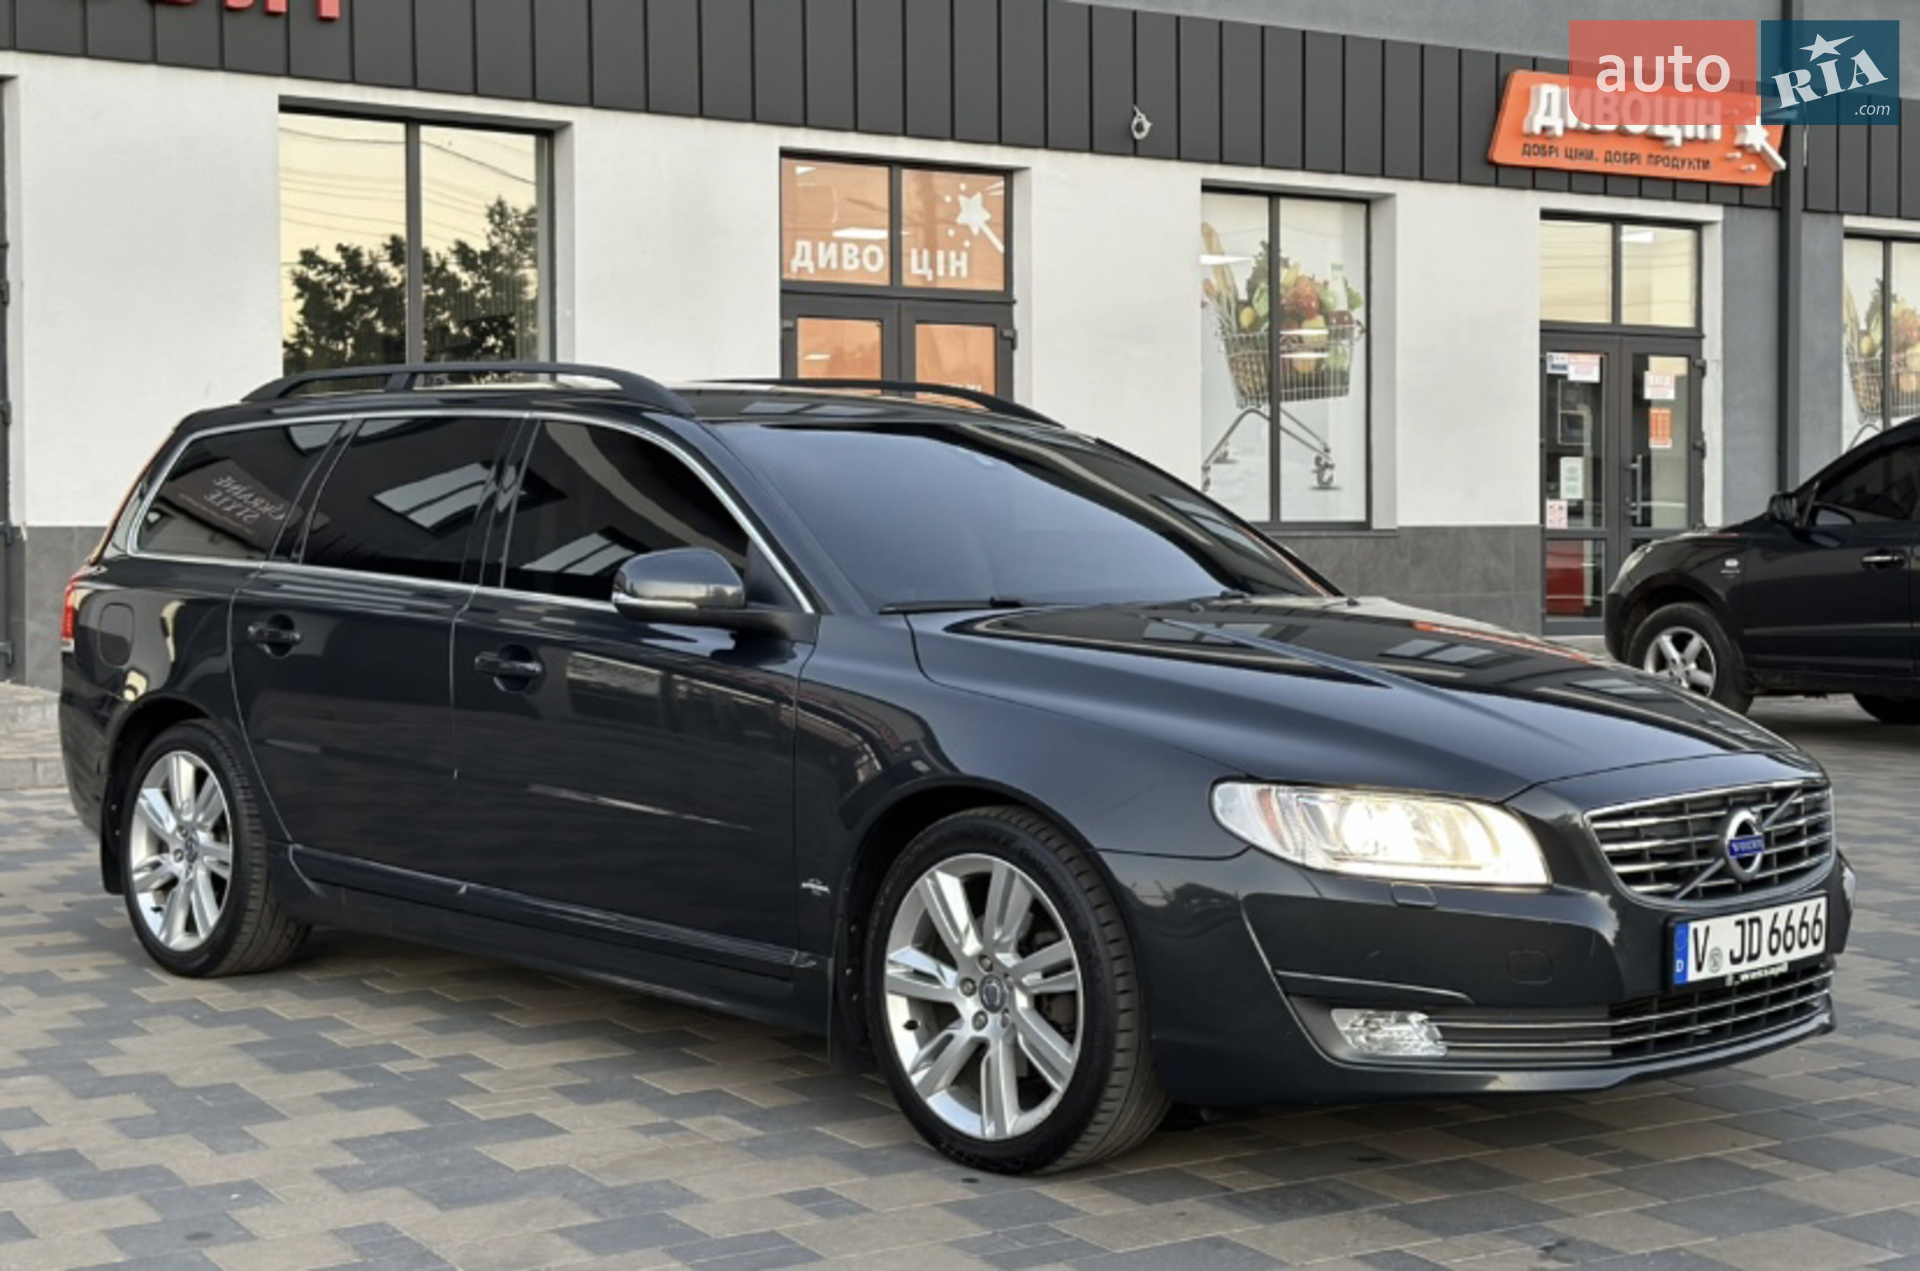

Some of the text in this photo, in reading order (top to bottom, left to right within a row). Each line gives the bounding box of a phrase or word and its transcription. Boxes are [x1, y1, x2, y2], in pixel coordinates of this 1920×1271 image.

[791, 239, 969, 282] ДИВО ЦІН
[1675, 960, 1684, 974] D
[1693, 925, 1710, 974] V
